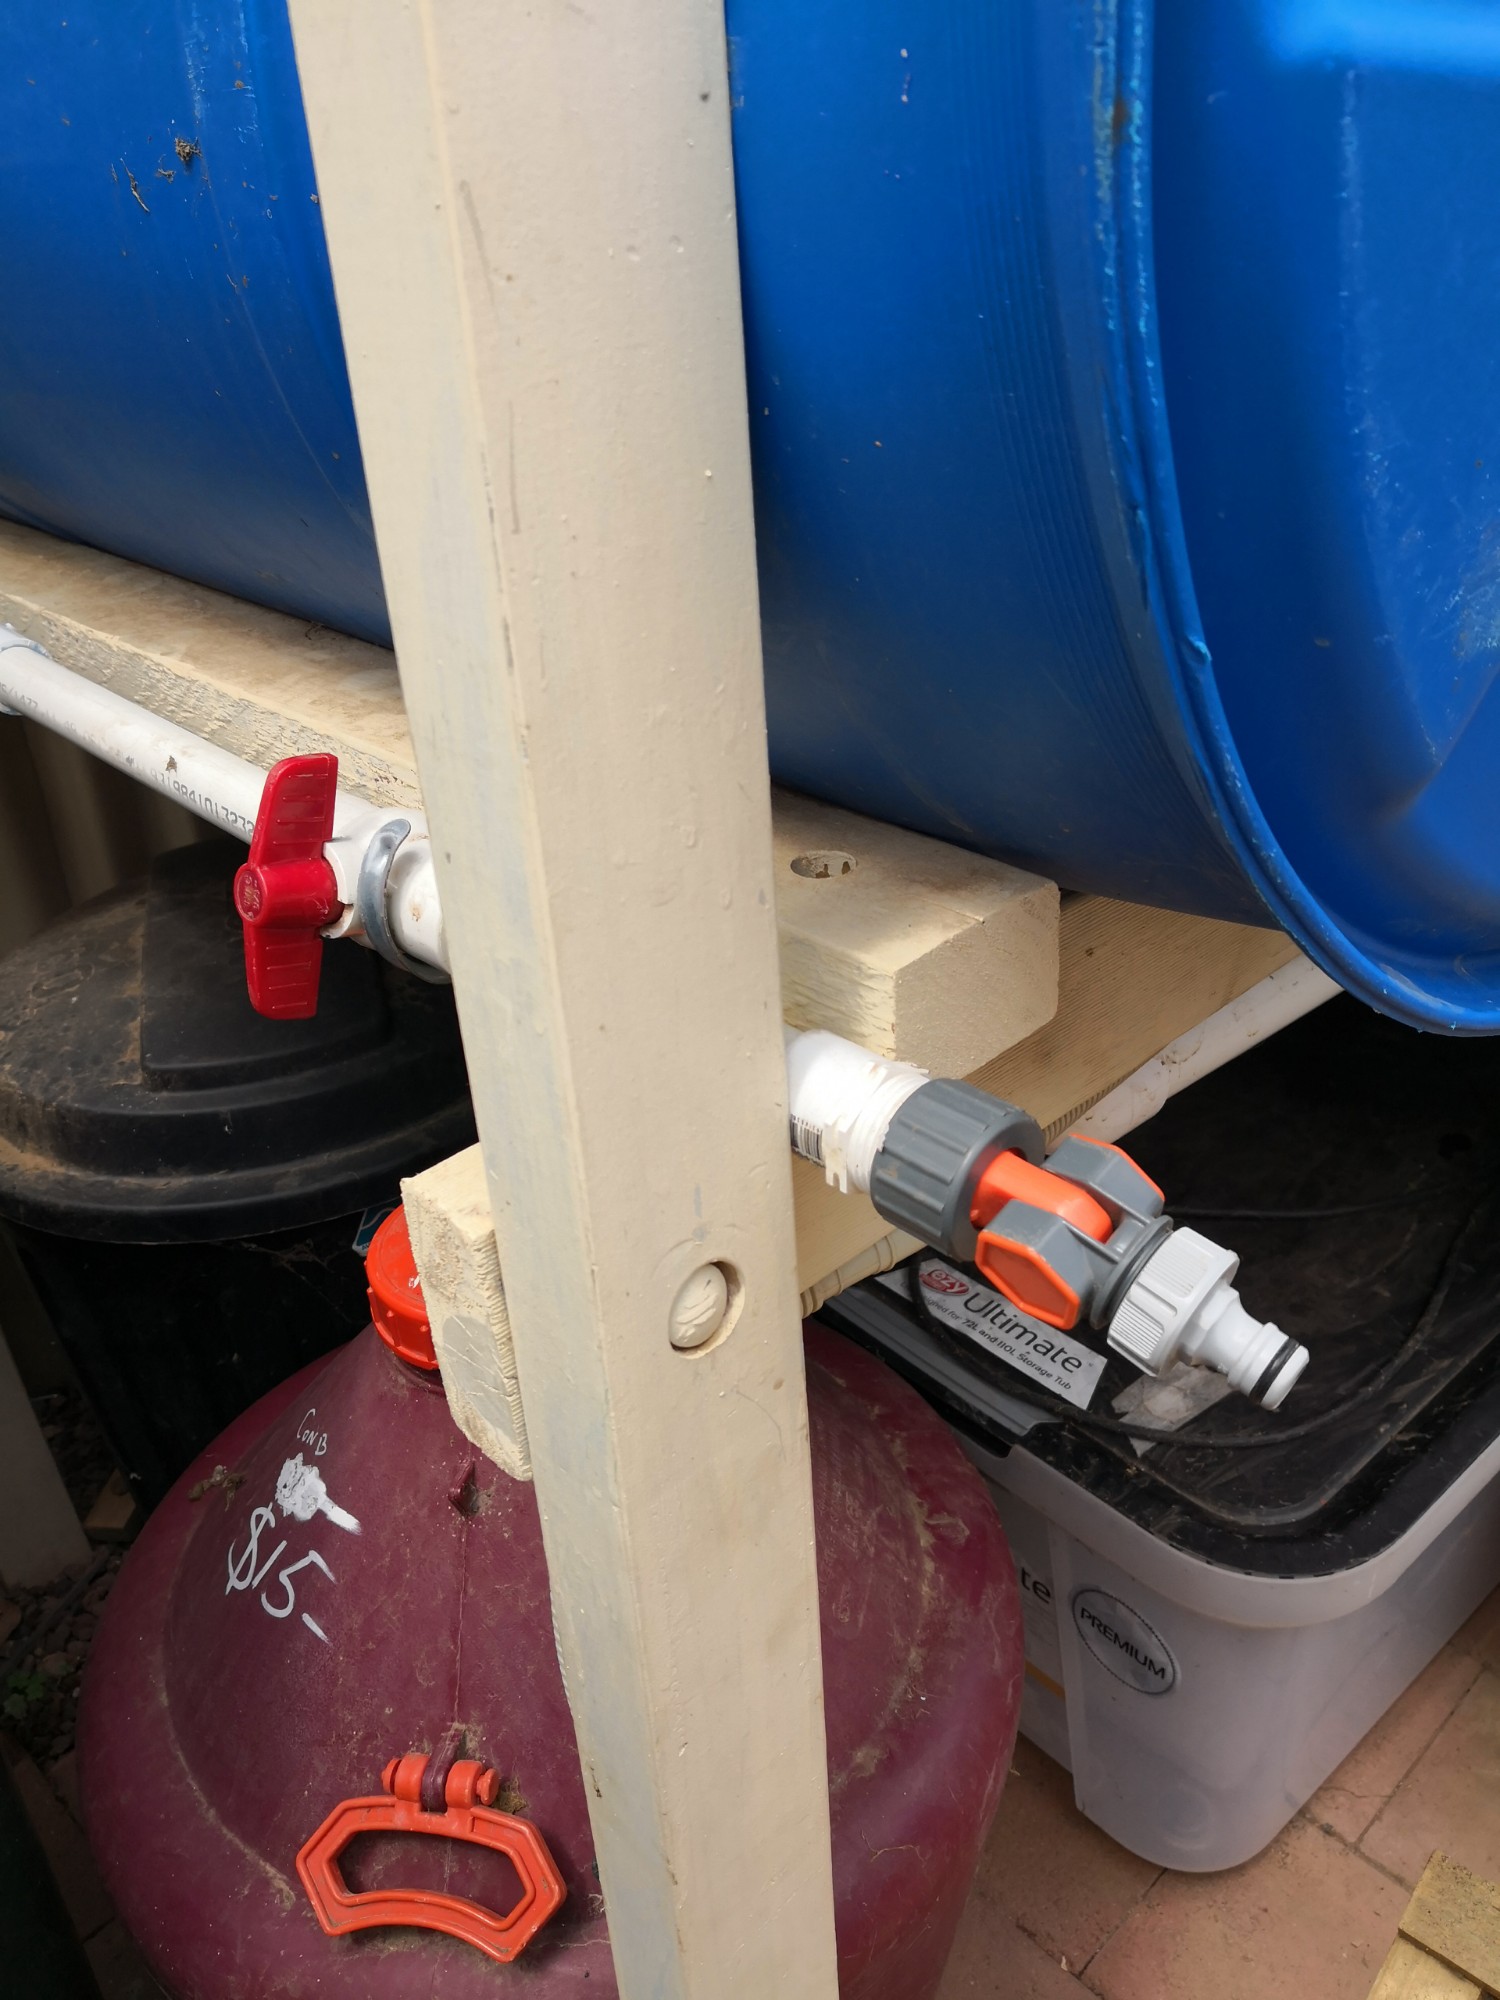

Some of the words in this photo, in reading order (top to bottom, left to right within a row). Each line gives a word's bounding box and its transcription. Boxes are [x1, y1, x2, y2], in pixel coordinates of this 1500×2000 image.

[963, 1292, 1083, 1374] Ultimate
[978, 1328, 998, 1344] and
[1016, 1352, 1053, 1379] Storage
[1054, 1375, 1073, 1390] Tub
[1080, 1607, 1166, 1681] PREMIUM
